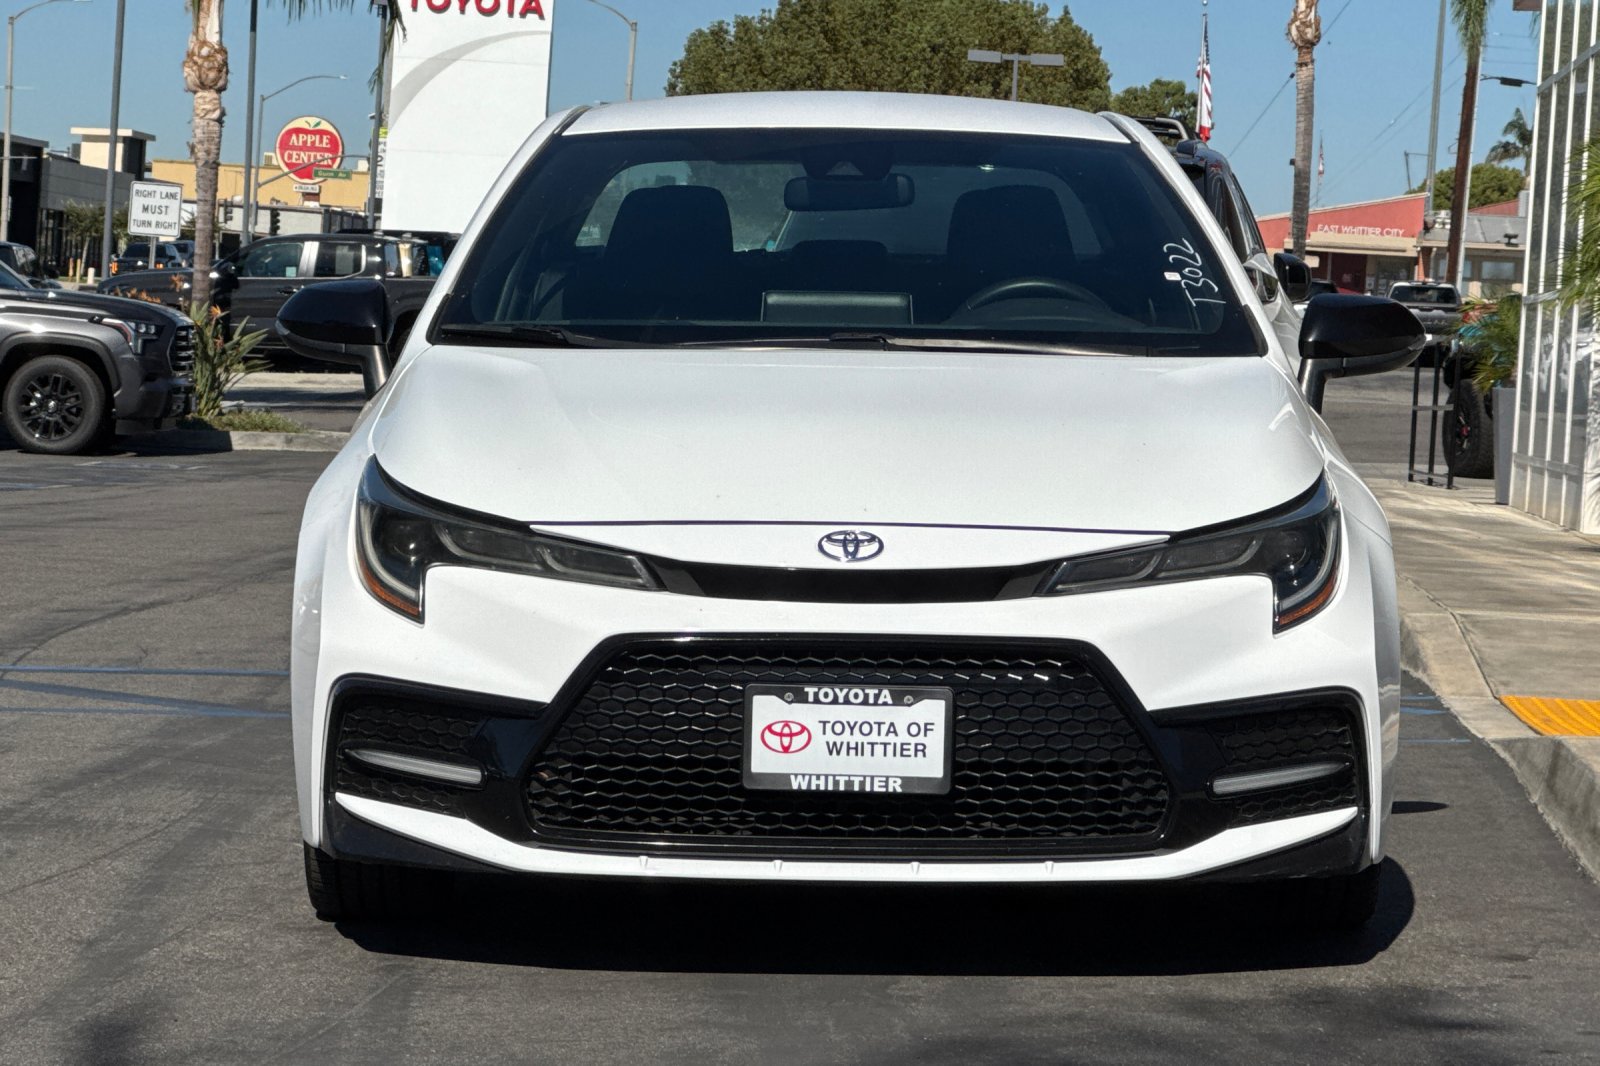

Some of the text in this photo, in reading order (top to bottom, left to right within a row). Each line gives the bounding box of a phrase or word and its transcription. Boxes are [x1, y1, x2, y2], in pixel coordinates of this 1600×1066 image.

[289, 133, 331, 148] APPLE
[284, 150, 333, 166] CENTER
[134, 189, 179, 200] RIGHT LANE
[141, 203, 169, 215] MUST
[132, 218, 177, 230] TURN RIGHT
[1317, 223, 1406, 237] EAST WHITTIER CITY
[804, 687, 893, 704] TOYOTA
[818, 720, 935, 738] TOYOTA OF
[825, 741, 927, 758] WHITTIER
[789, 774, 903, 793] WHITTIER
